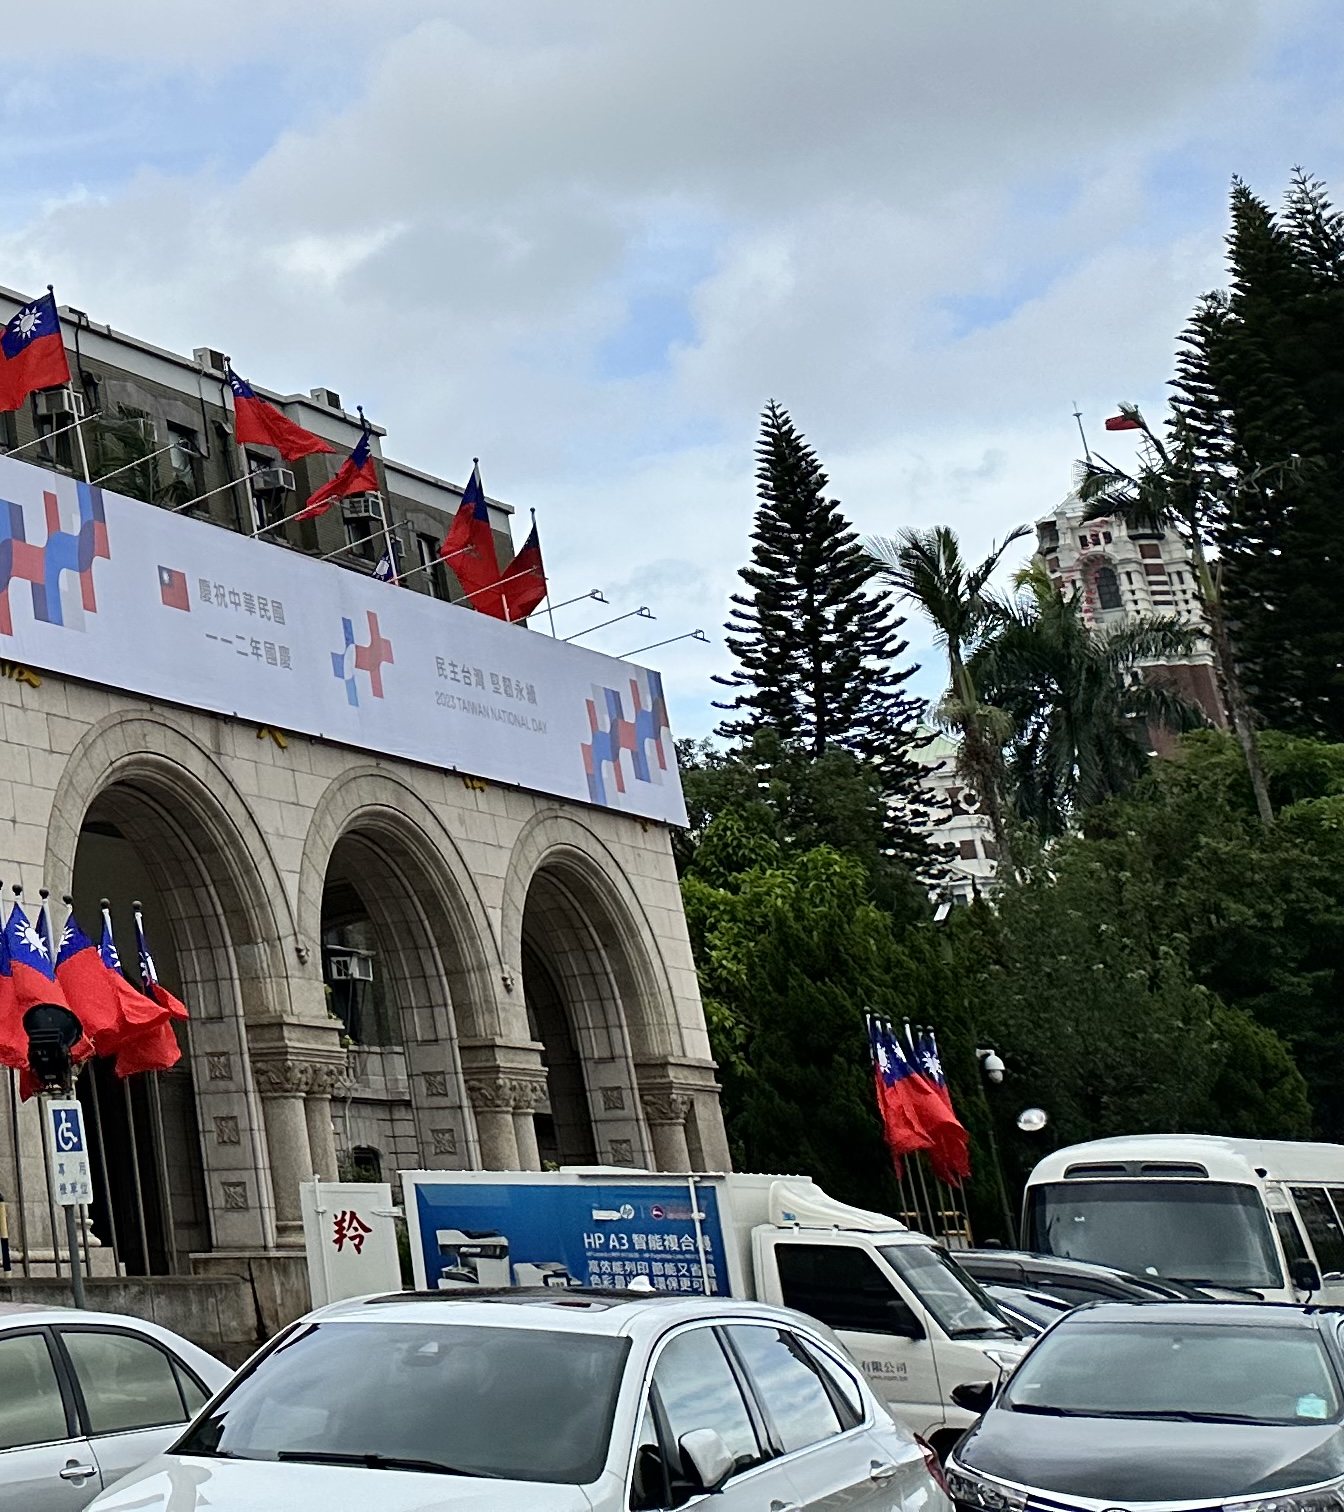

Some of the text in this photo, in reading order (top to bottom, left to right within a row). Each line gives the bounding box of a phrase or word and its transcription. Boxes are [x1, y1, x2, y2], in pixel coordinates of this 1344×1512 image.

[198, 578, 286, 626] 慶祝中華民國
[205, 633, 293, 671] 一一二年國慶
[435, 655, 485, 690] 民主台灣
[435, 690, 548, 734] 2023 TAIWAN NATIONAL DAY
[332, 1210, 373, 1257] 羚
[583, 1232, 605, 1249] HP
[609, 1233, 629, 1250] A3
[861, 1360, 908, 1375] 有限公司
